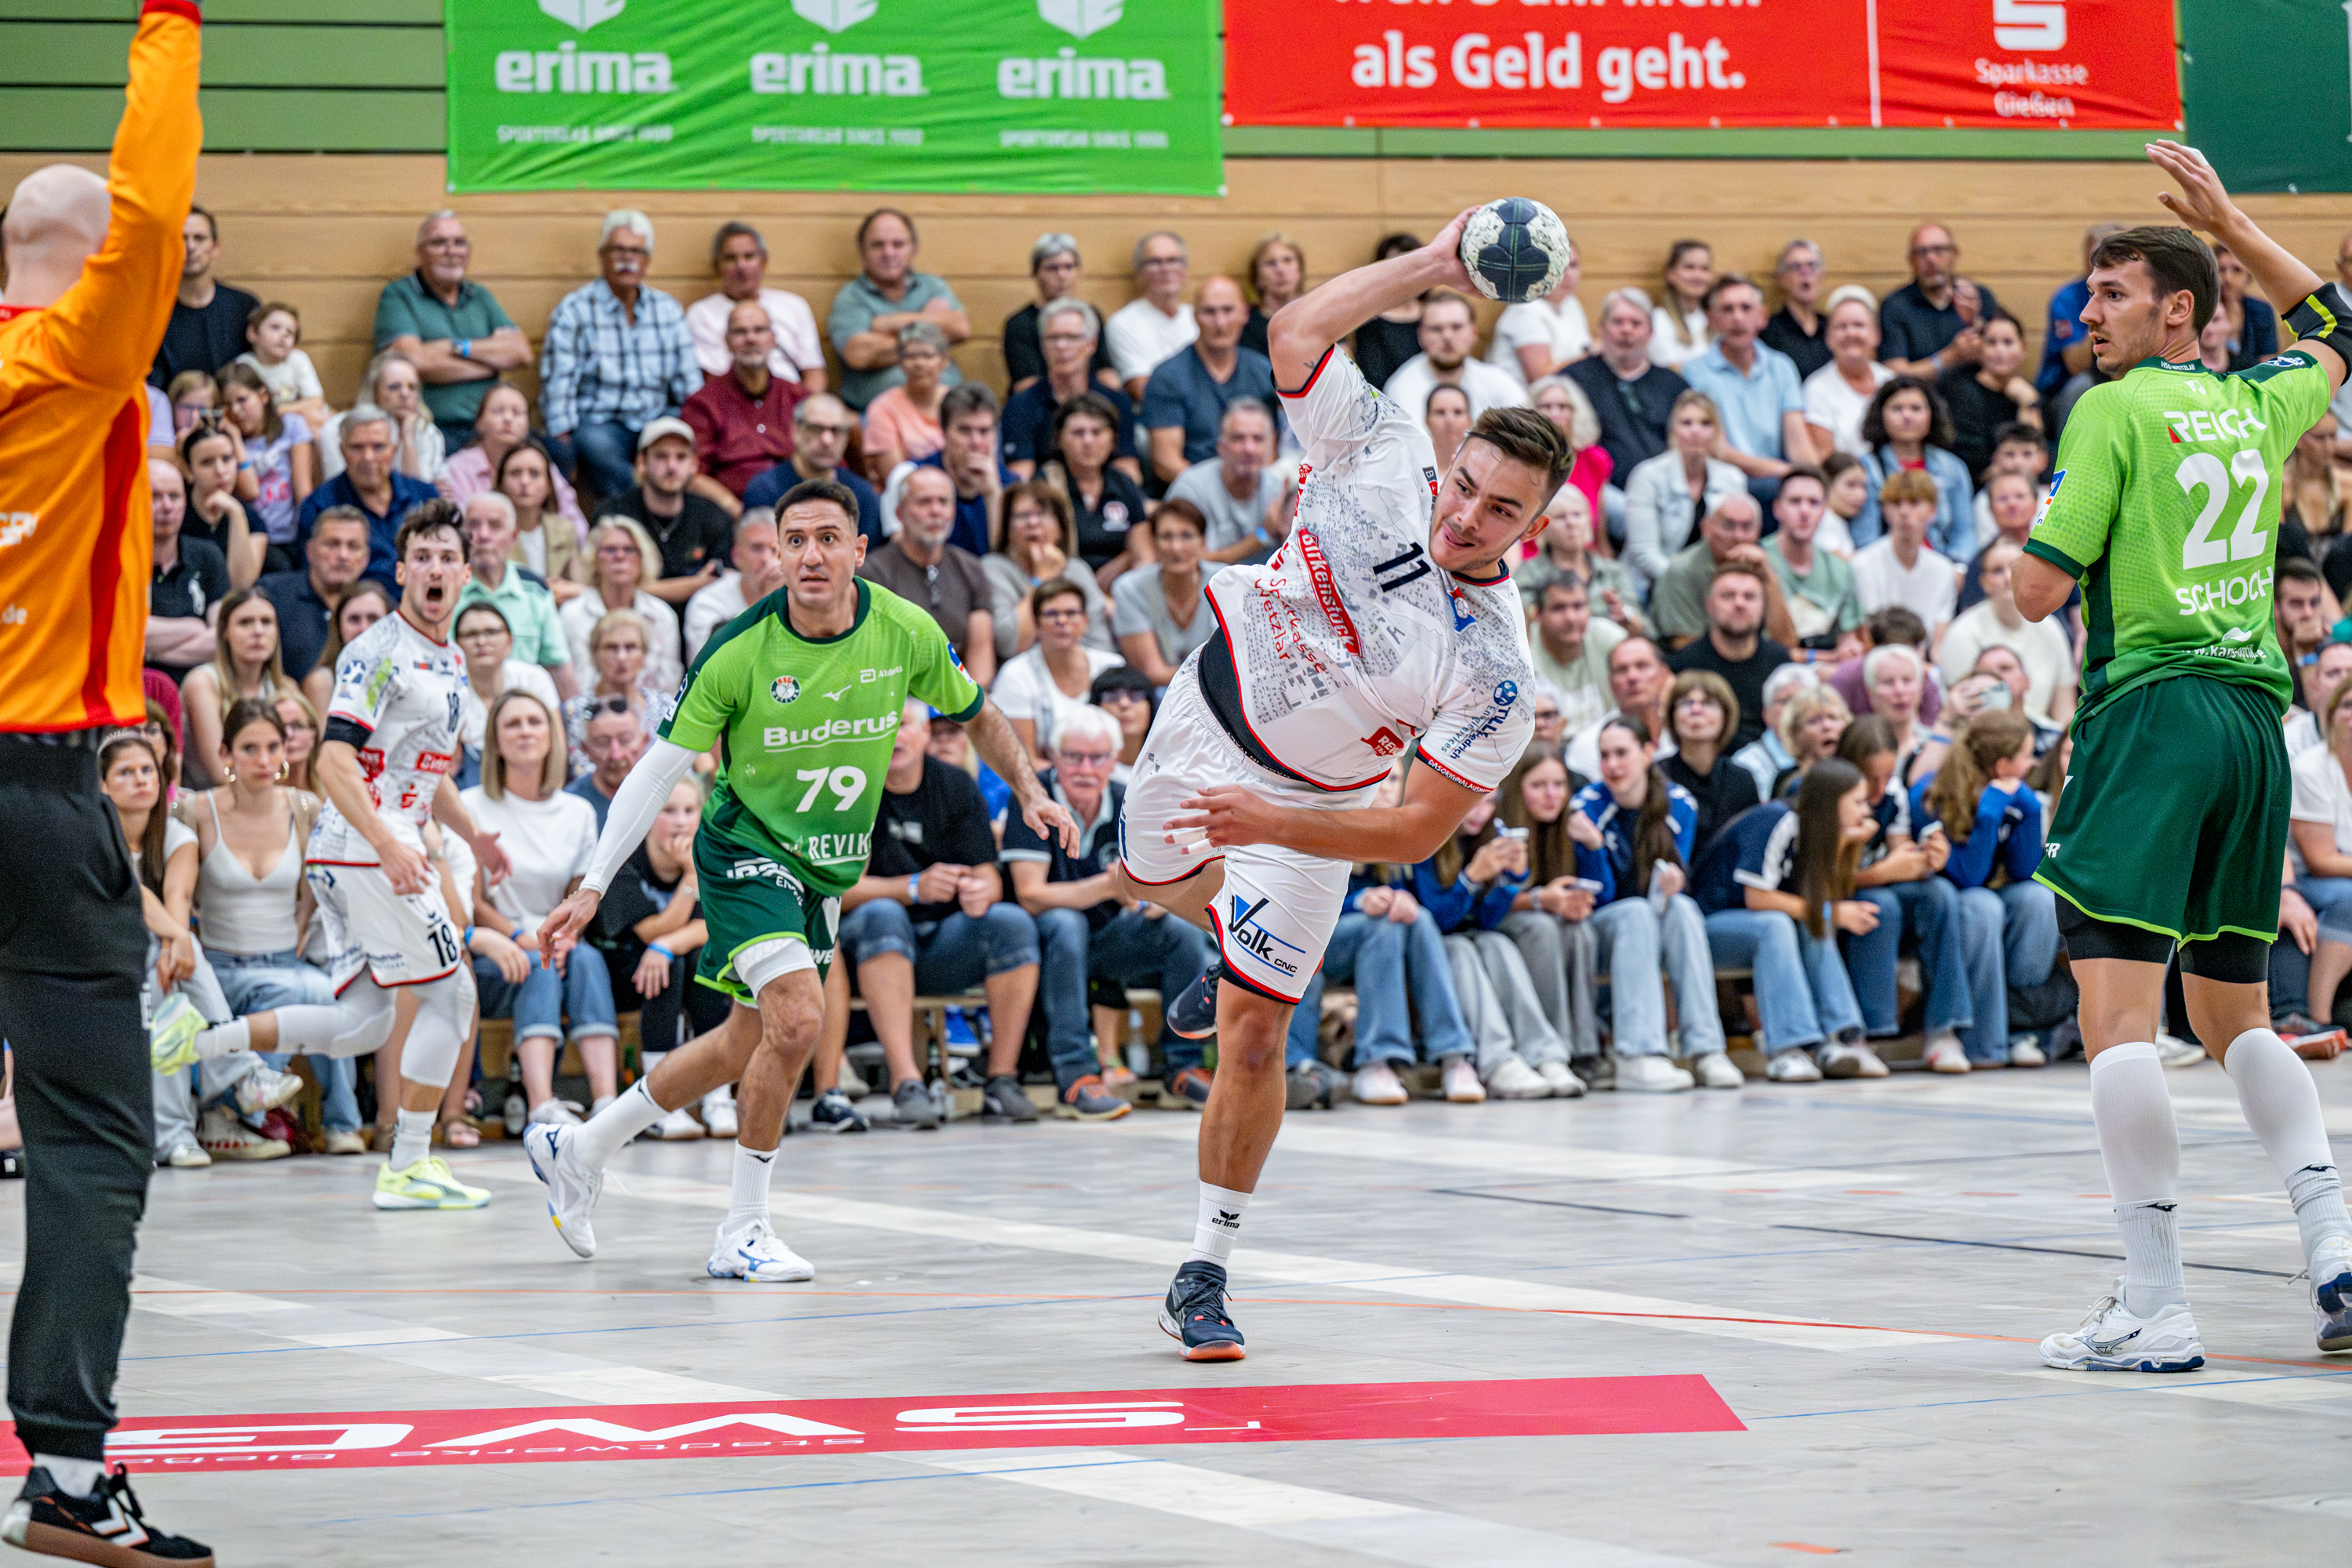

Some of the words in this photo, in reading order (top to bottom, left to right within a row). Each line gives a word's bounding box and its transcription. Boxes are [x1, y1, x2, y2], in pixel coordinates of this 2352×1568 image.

[495, 41, 674, 93] erima
[750, 43, 925, 96] erima
[996, 47, 1168, 100] erima
[1351, 29, 1438, 88] als
[1450, 31, 1582, 89] Geld
[1596, 31, 1747, 103] geht.
[1973, 57, 2089, 88] Sparkasse
[1994, 90, 2076, 118] Gießen
[2163, 408, 2267, 443] REICH
[2174, 448, 2269, 570] 22
[1373, 543, 1431, 592] 11
[2175, 565, 2274, 615] SCHOCH
[764, 710, 899, 746] Buderus
[795, 765, 867, 813] 79
[428, 924, 458, 967] 18
[1274, 957, 1298, 974] CNC
[1211, 1217, 1240, 1229] erima
[112, 1453, 337, 1465] Gieße
[390, 1438, 865, 1459] Stadtwerke
